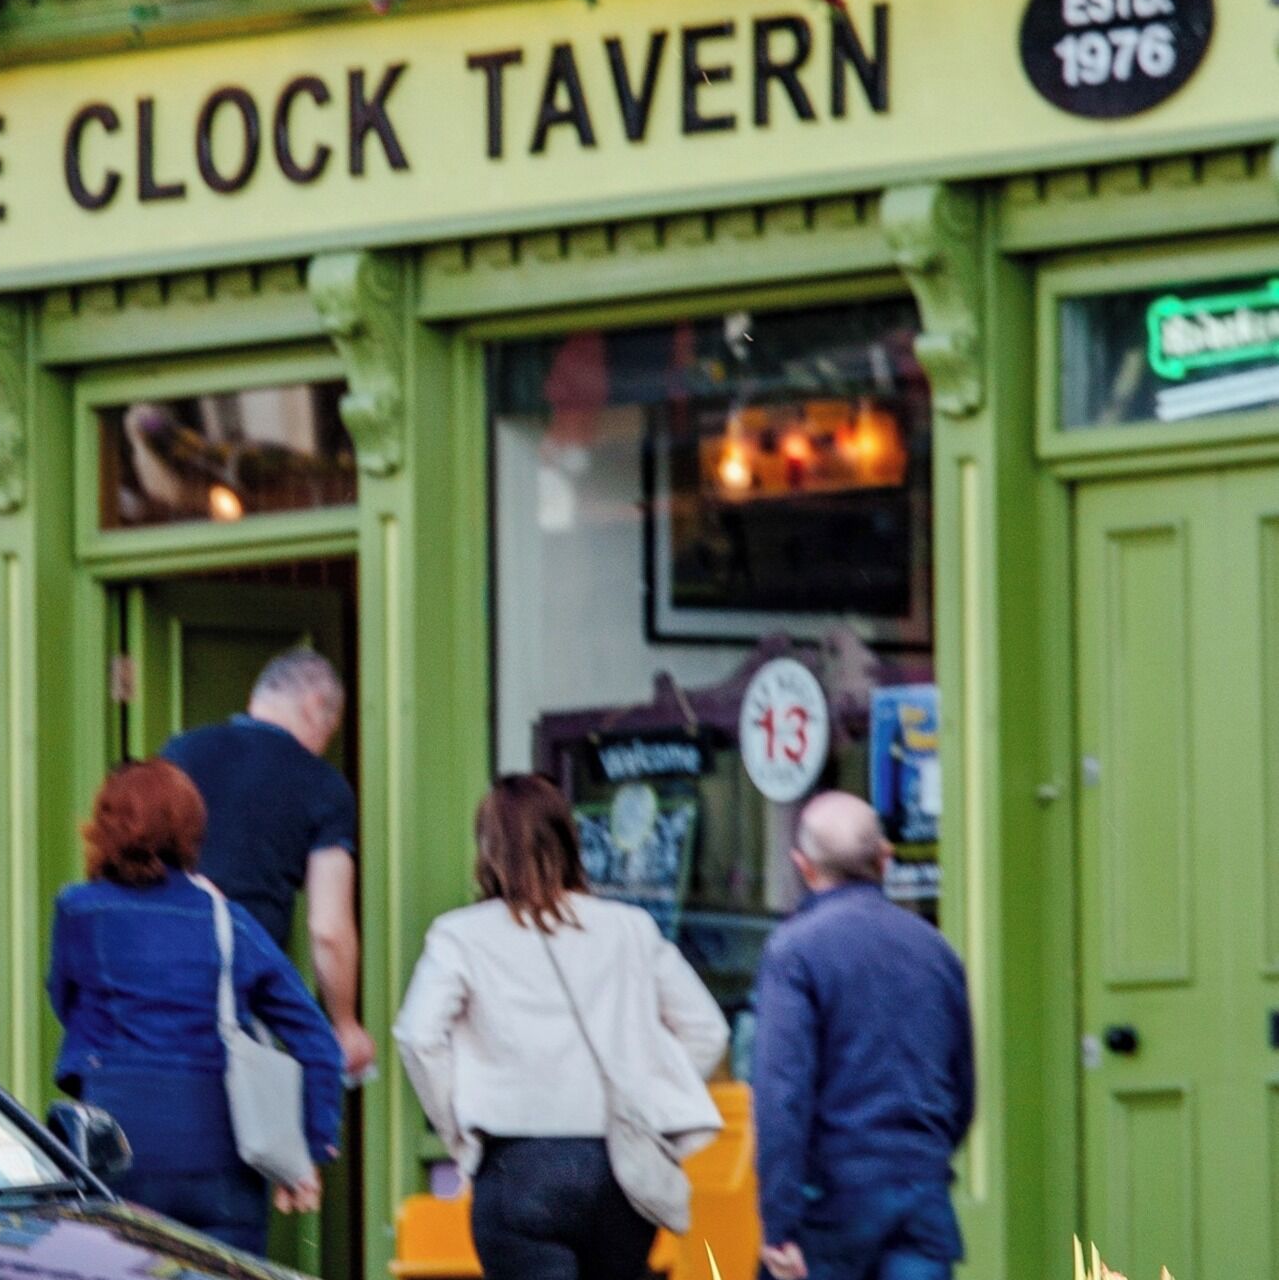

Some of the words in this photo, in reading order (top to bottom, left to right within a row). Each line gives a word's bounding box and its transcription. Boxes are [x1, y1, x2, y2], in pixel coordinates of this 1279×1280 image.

[1053, 23, 1176, 87] 1976
[64, 61, 410, 211] CLOCK
[466, 2, 893, 160] TAVERN
[757, 705, 811, 764] 13
